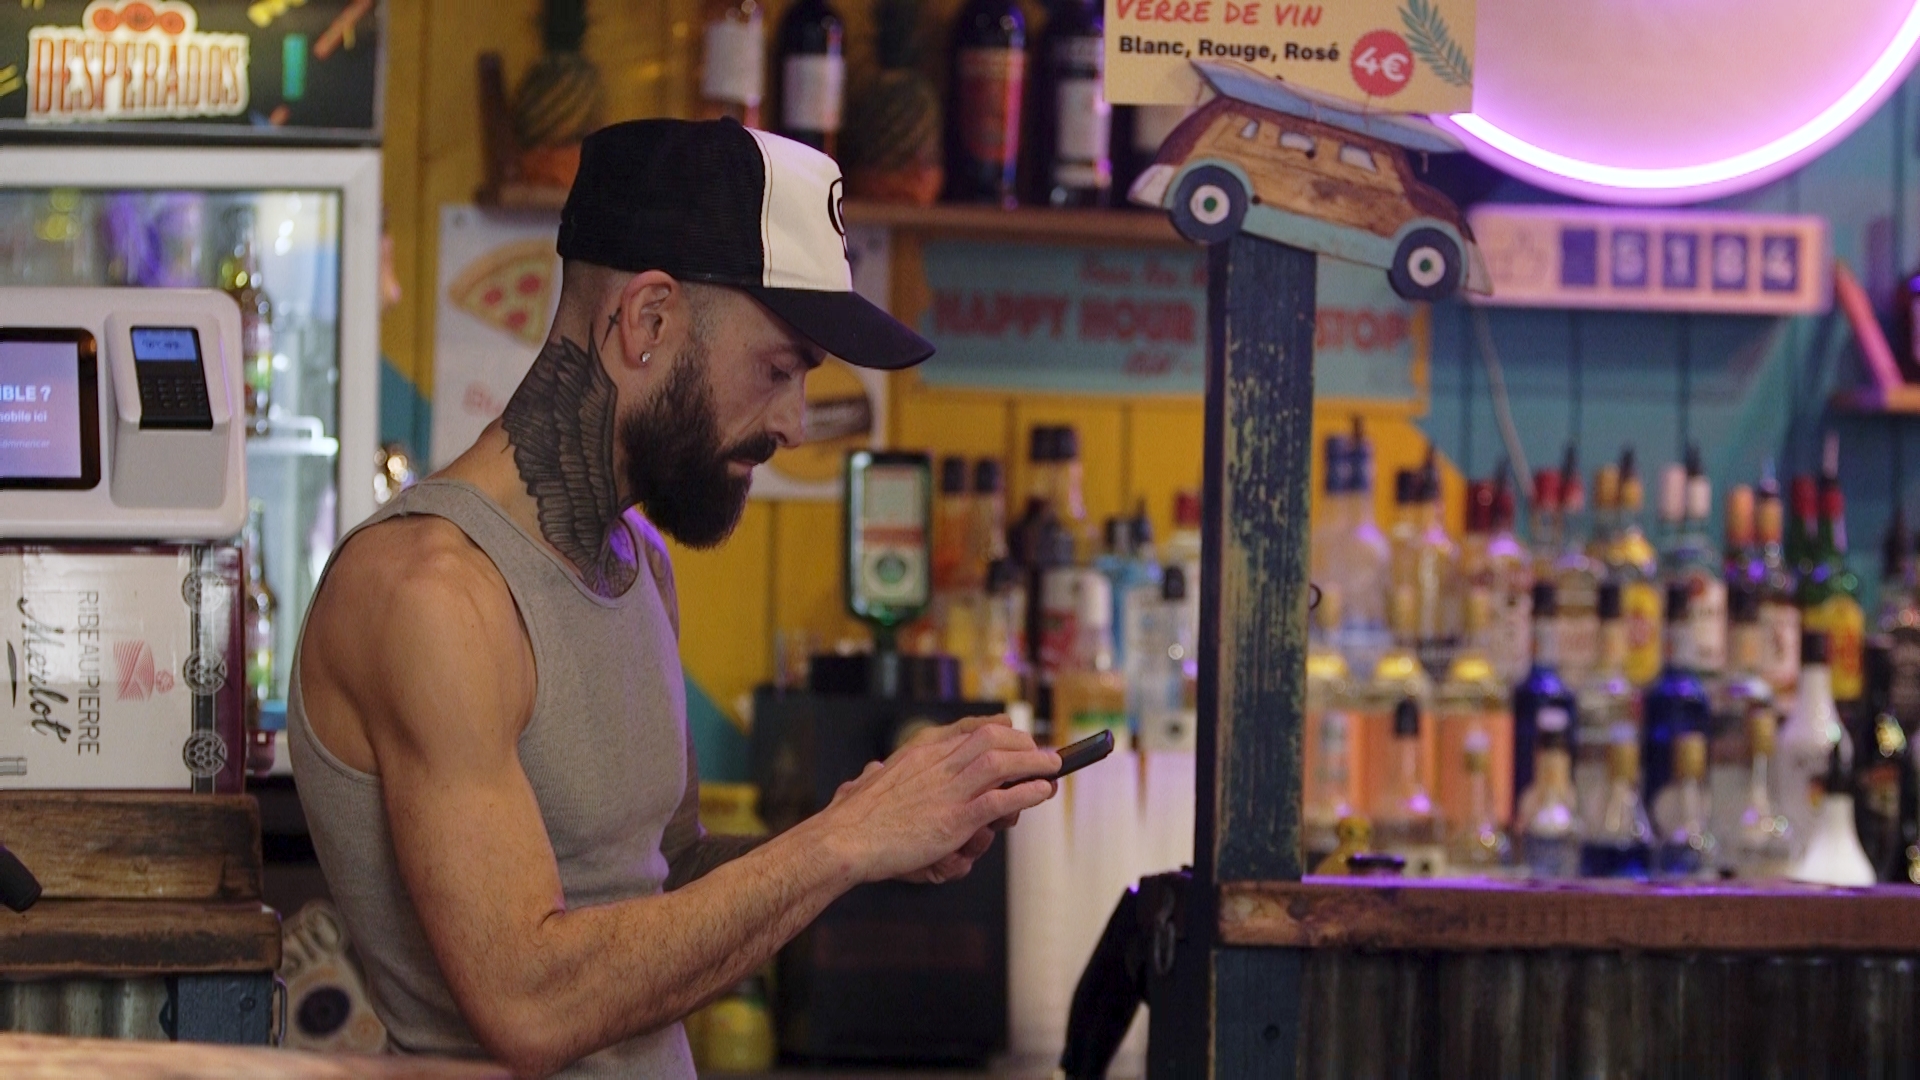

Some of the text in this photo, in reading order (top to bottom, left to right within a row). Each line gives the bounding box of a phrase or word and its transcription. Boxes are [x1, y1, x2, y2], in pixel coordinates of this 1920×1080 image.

[1116, 0, 1323, 27] VERRE DE VIN
[1119, 36, 1339, 62] Blanc, Rouge, Rosé
[1355, 47, 1409, 82] 4€
[30, 32, 246, 118] DESPERADOS
[935, 289, 1067, 339] HAPPY
[1080, 297, 1195, 343] HOUR
[40, 385, 51, 402] ?
[17, 597, 71, 743] Merlot
[78, 591, 100, 756] RIBEAUPIERRE
